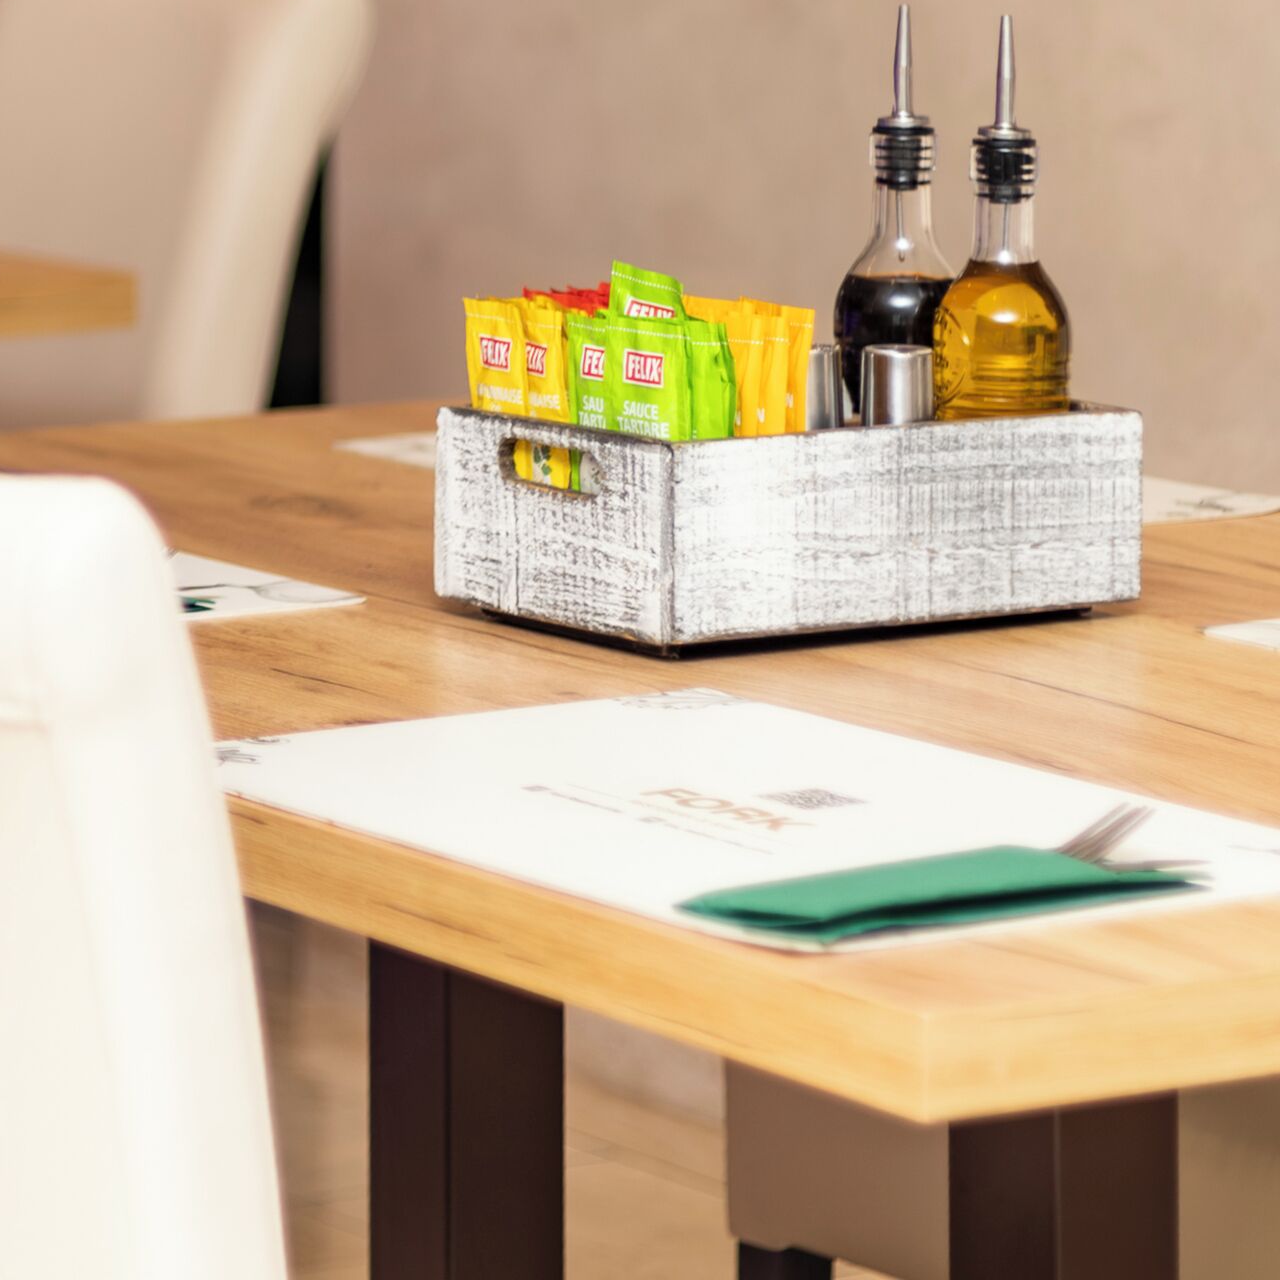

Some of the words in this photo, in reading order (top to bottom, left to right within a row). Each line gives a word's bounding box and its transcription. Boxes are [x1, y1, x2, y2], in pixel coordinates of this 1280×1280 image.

[626, 353, 660, 383] FELIX
[623, 399, 659, 420] SAUCE
[617, 416, 670, 439] TARTARE
[639, 786, 818, 832] FORK
